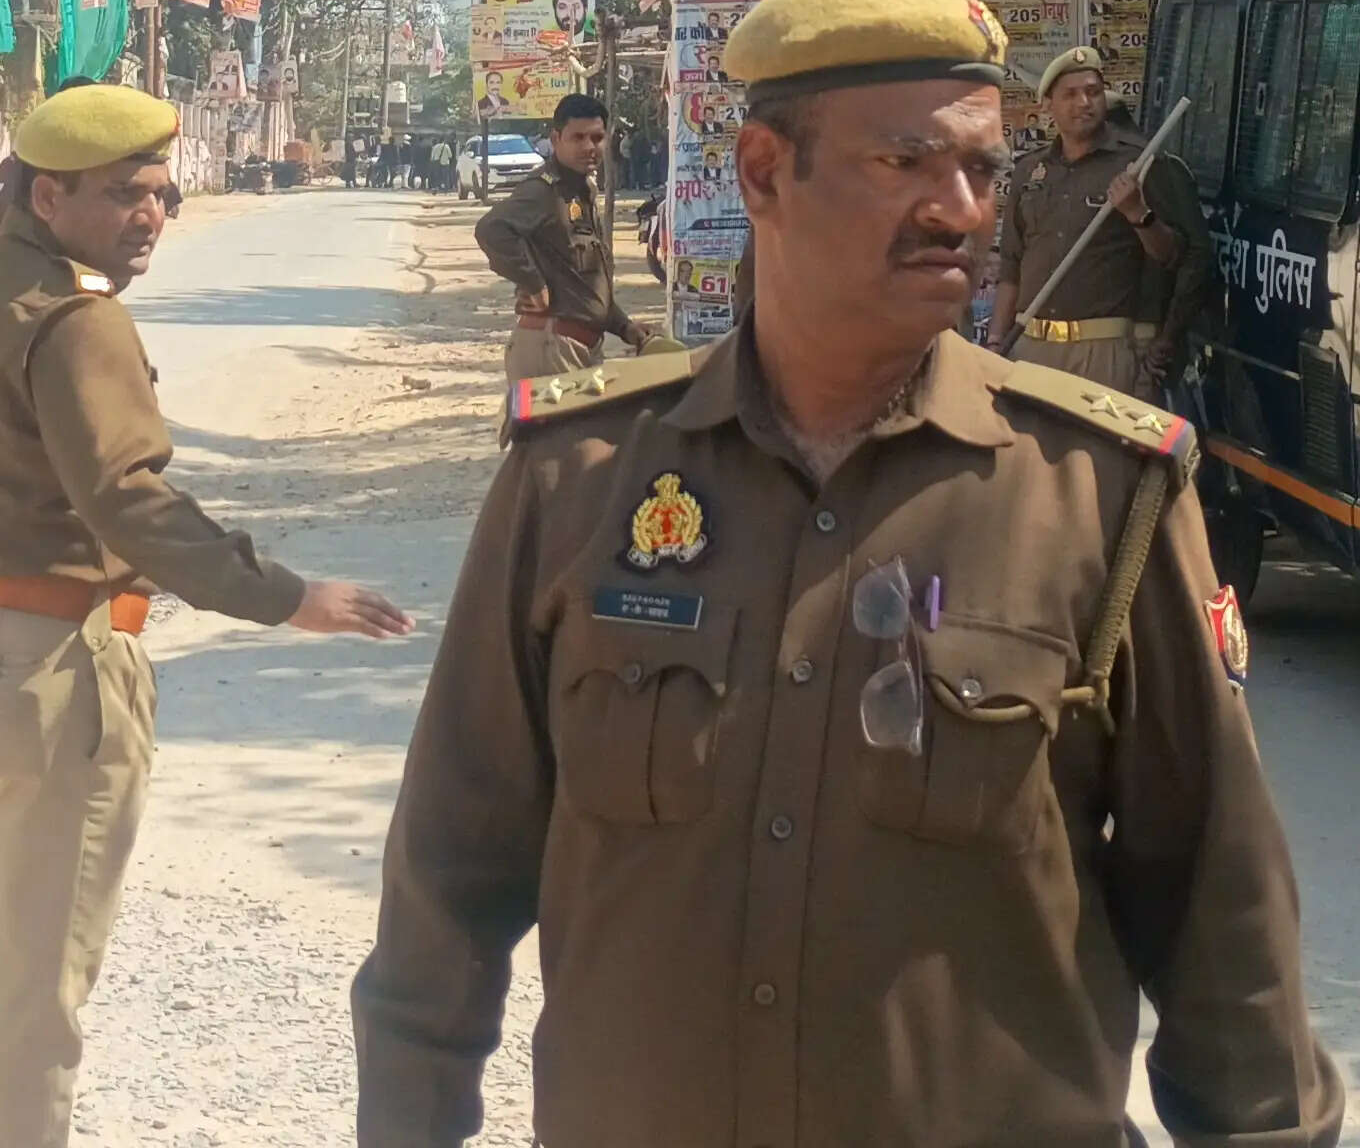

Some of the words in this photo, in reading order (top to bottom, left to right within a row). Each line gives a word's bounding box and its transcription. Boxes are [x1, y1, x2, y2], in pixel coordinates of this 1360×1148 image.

[1009, 8, 1041, 23] 205
[1254, 228, 1317, 314] पुलिस
[701, 276, 728, 295] 61
